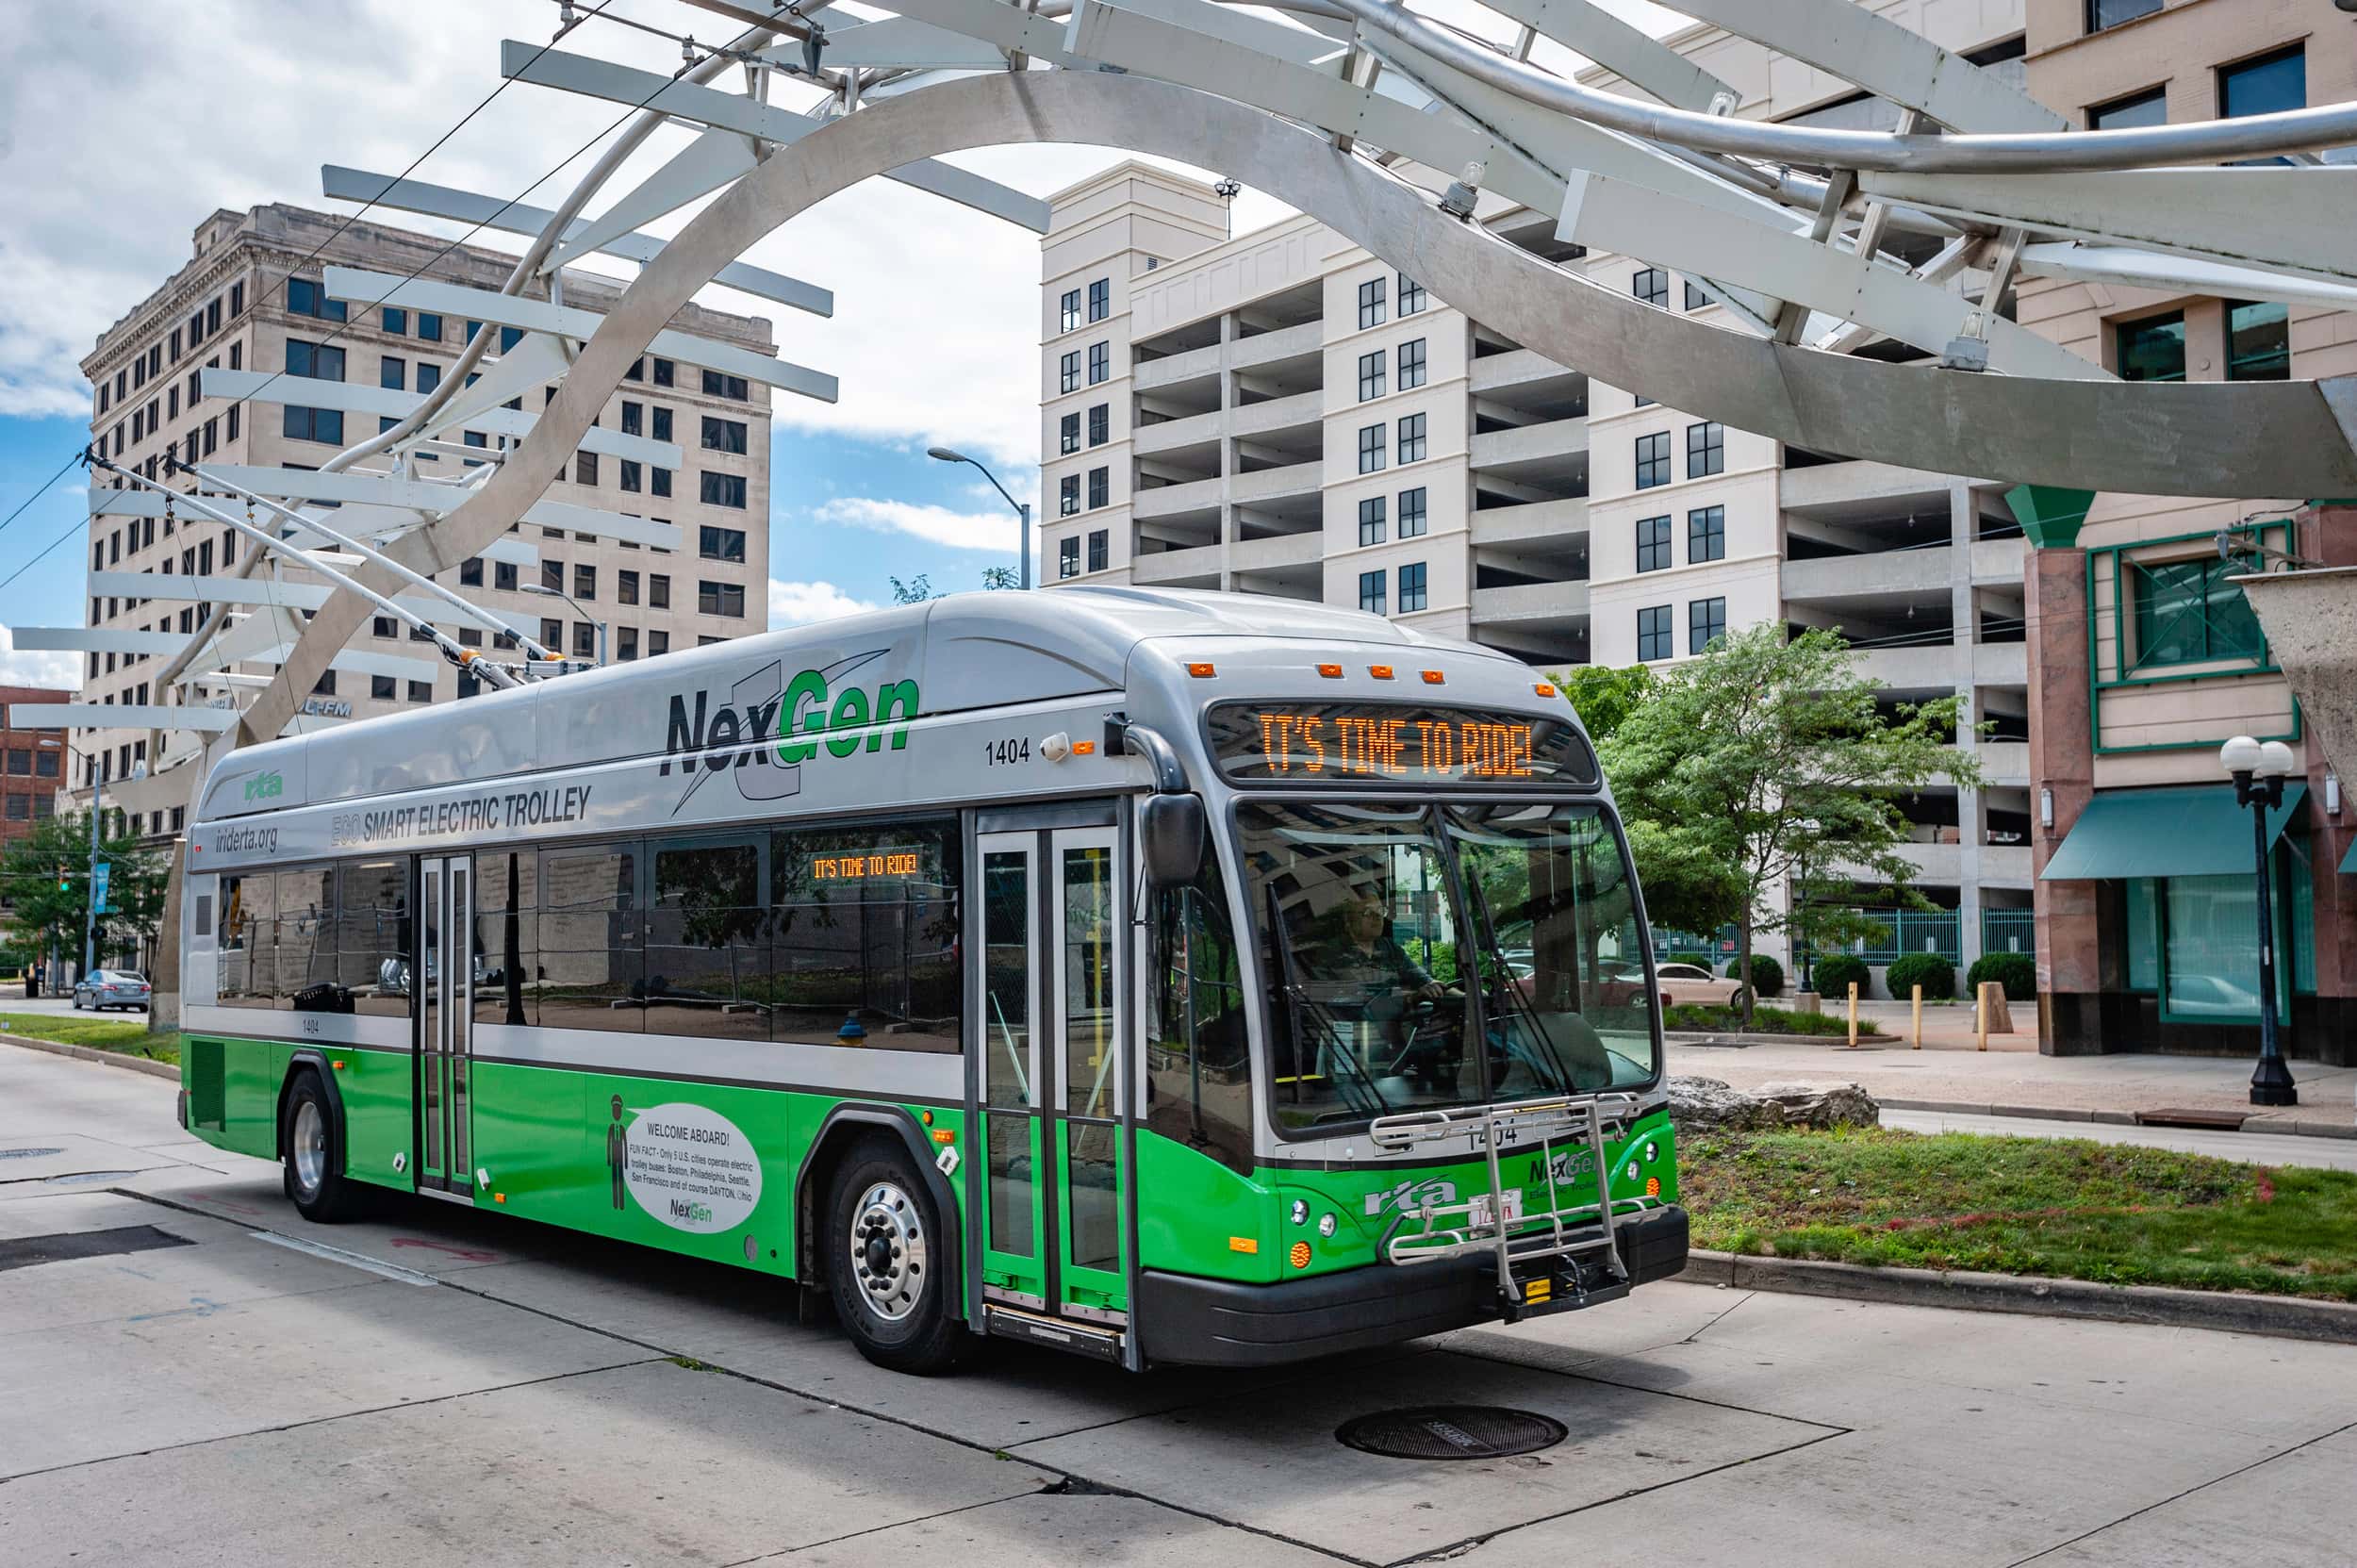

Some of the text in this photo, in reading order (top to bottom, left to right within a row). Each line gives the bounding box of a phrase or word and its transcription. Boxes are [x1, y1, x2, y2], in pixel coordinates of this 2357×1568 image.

[660, 669, 920, 777] NexGen
[985, 736, 1030, 767] 1404
[1260, 715, 1532, 776] IT'S TIME TO RIDE!
[244, 769, 283, 806] rta
[363, 806, 416, 842] SMART
[418, 796, 500, 836] ELECTRIC
[504, 784, 592, 828] TROLLEY
[216, 827, 278, 853] iriderta.org
[814, 853, 916, 879] IT'S TIME TO RIDE!
[303, 1018, 320, 1034] 1404
[647, 1122, 730, 1147] WELCOME ABOARD!
[629, 1144, 641, 1154] FUN
[641, 1146, 656, 1157] FACT
[660, 1147, 672, 1163] Only
[679, 1151, 690, 1163] U.S.
[731, 1160, 754, 1172] electric
[632, 1171, 642, 1182] San
[642, 1174, 669, 1188] Francisco
[669, 1180, 681, 1190] and
[688, 1182, 709, 1194] course
[670, 1198, 712, 1223] NexGen
[1364, 1177, 1456, 1218] rta
